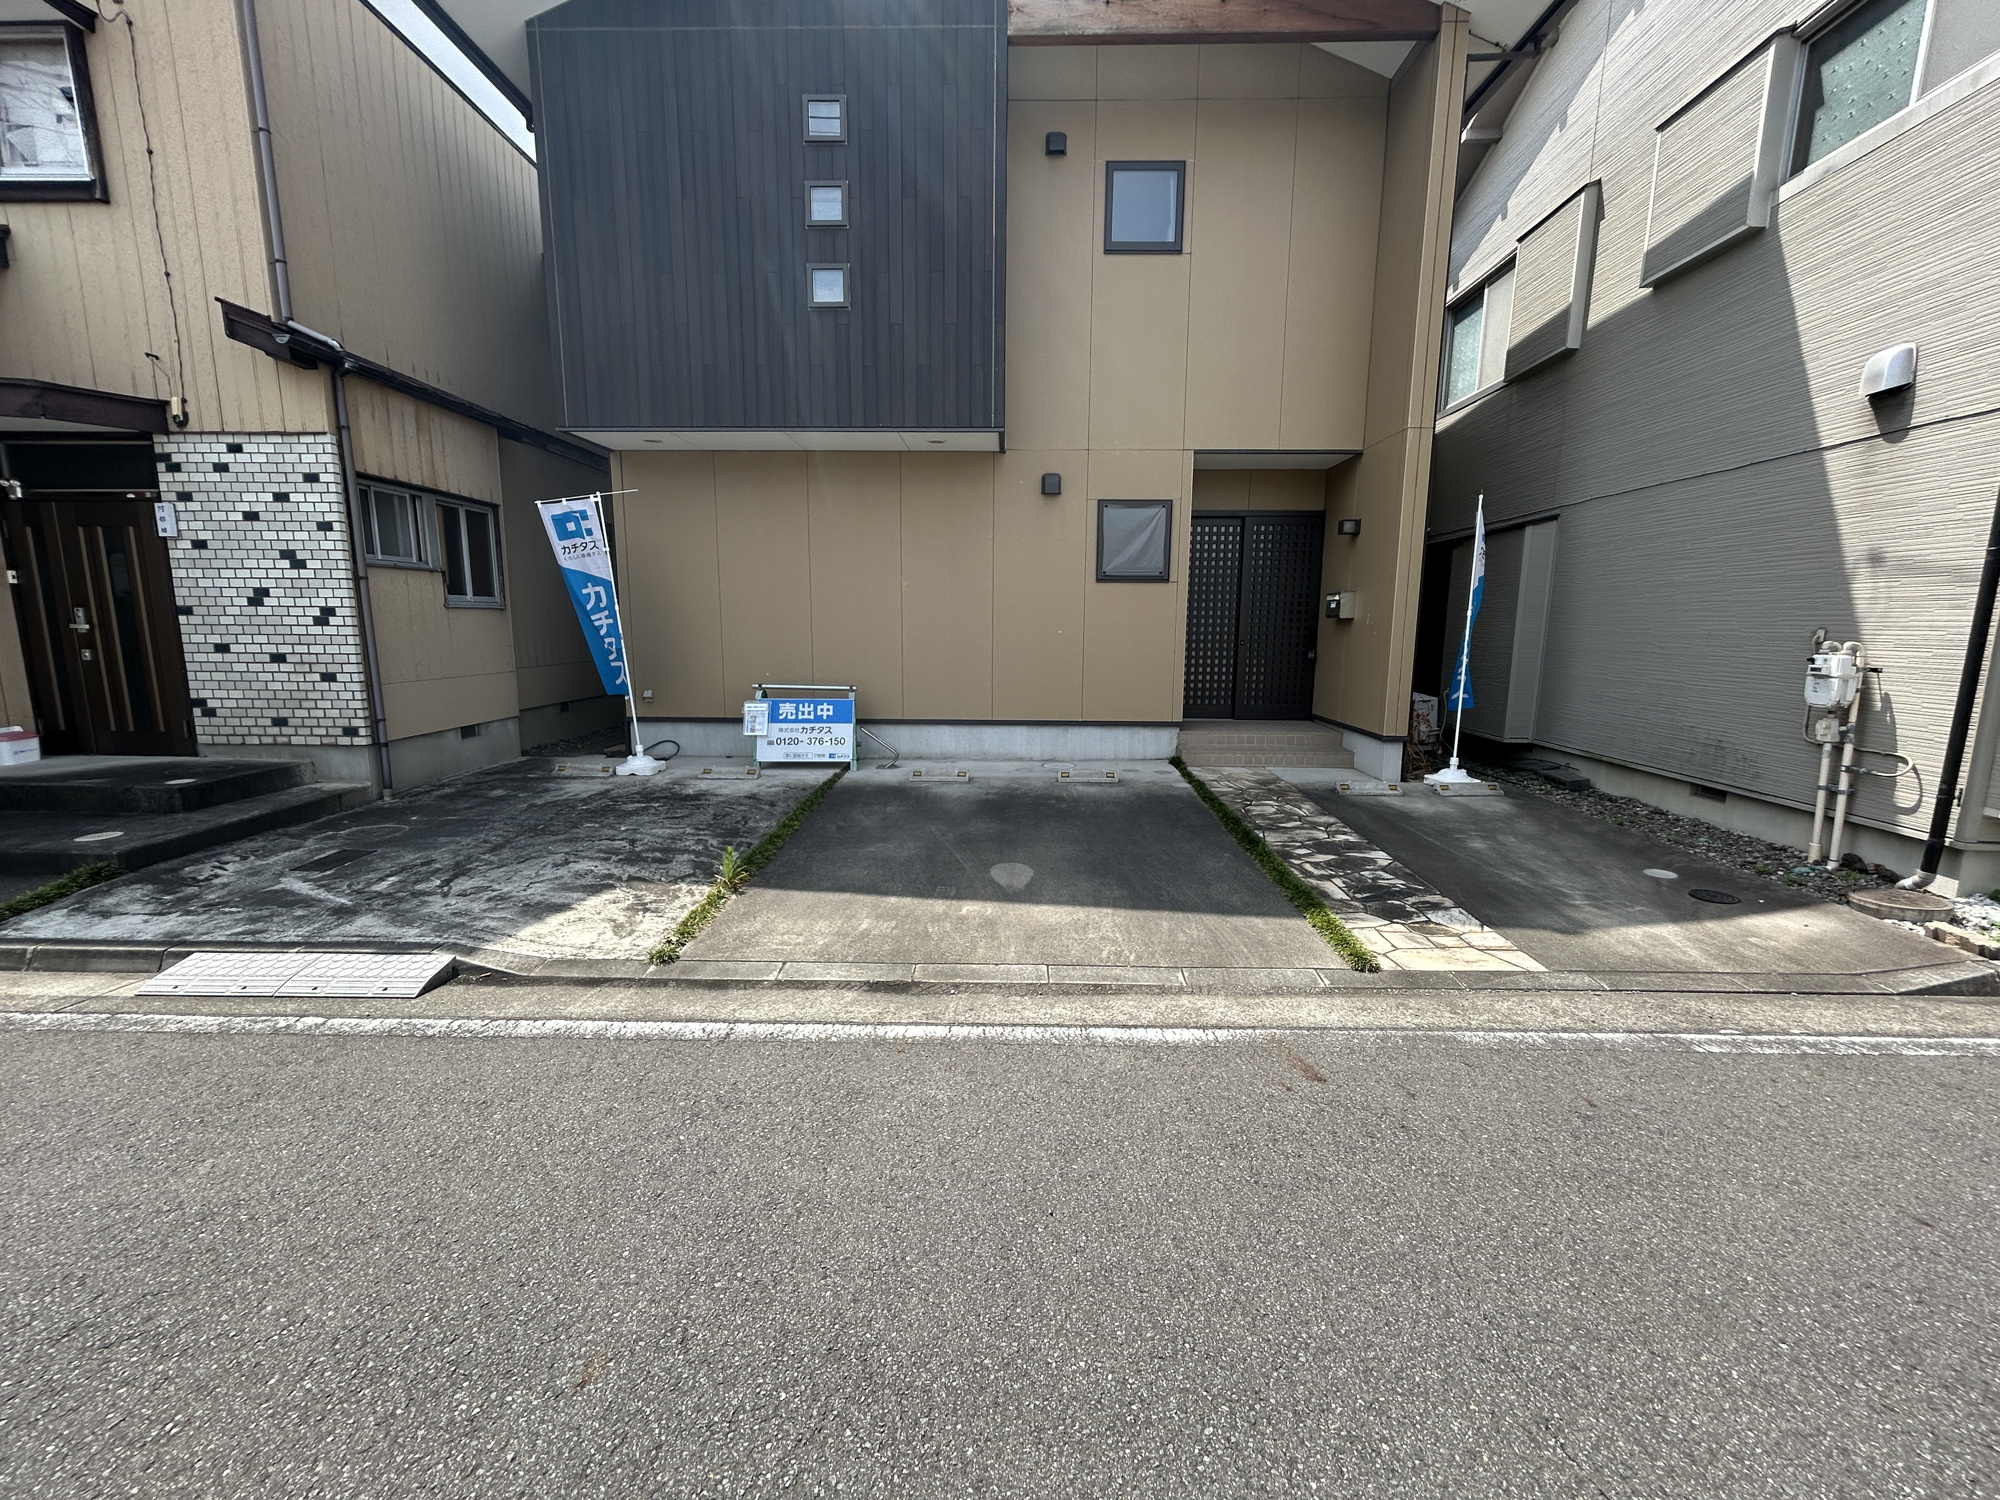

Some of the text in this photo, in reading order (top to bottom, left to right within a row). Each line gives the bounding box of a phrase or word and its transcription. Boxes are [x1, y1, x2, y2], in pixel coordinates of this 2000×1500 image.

[561, 541, 599, 555] カチタス
[582, 583, 628, 685] カチタス
[779, 703, 833, 720] 売出中
